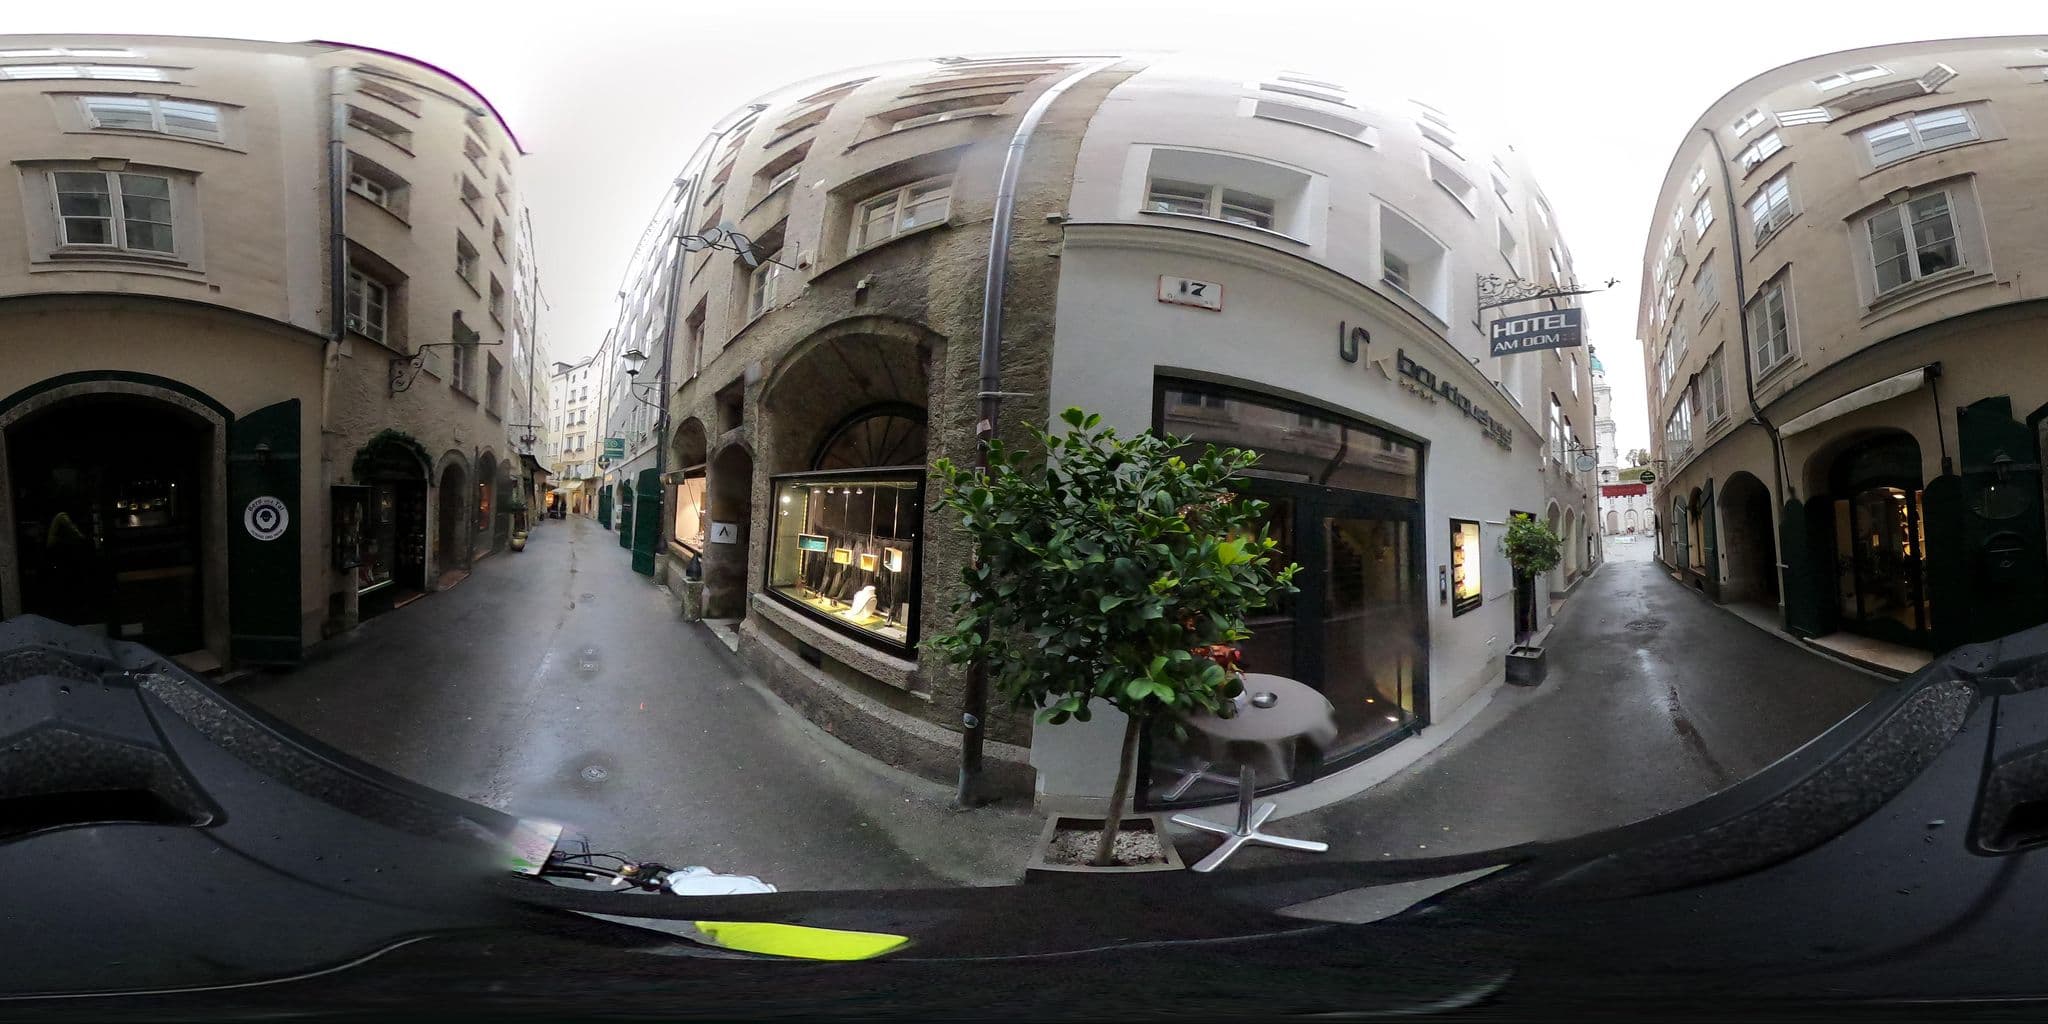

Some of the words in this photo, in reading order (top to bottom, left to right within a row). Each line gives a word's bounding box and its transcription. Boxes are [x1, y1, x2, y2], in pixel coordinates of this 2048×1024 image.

[1180, 280, 1207, 297] 17
[1493, 313, 1577, 338] HOTEL
[1494, 339, 1518, 352] AM
